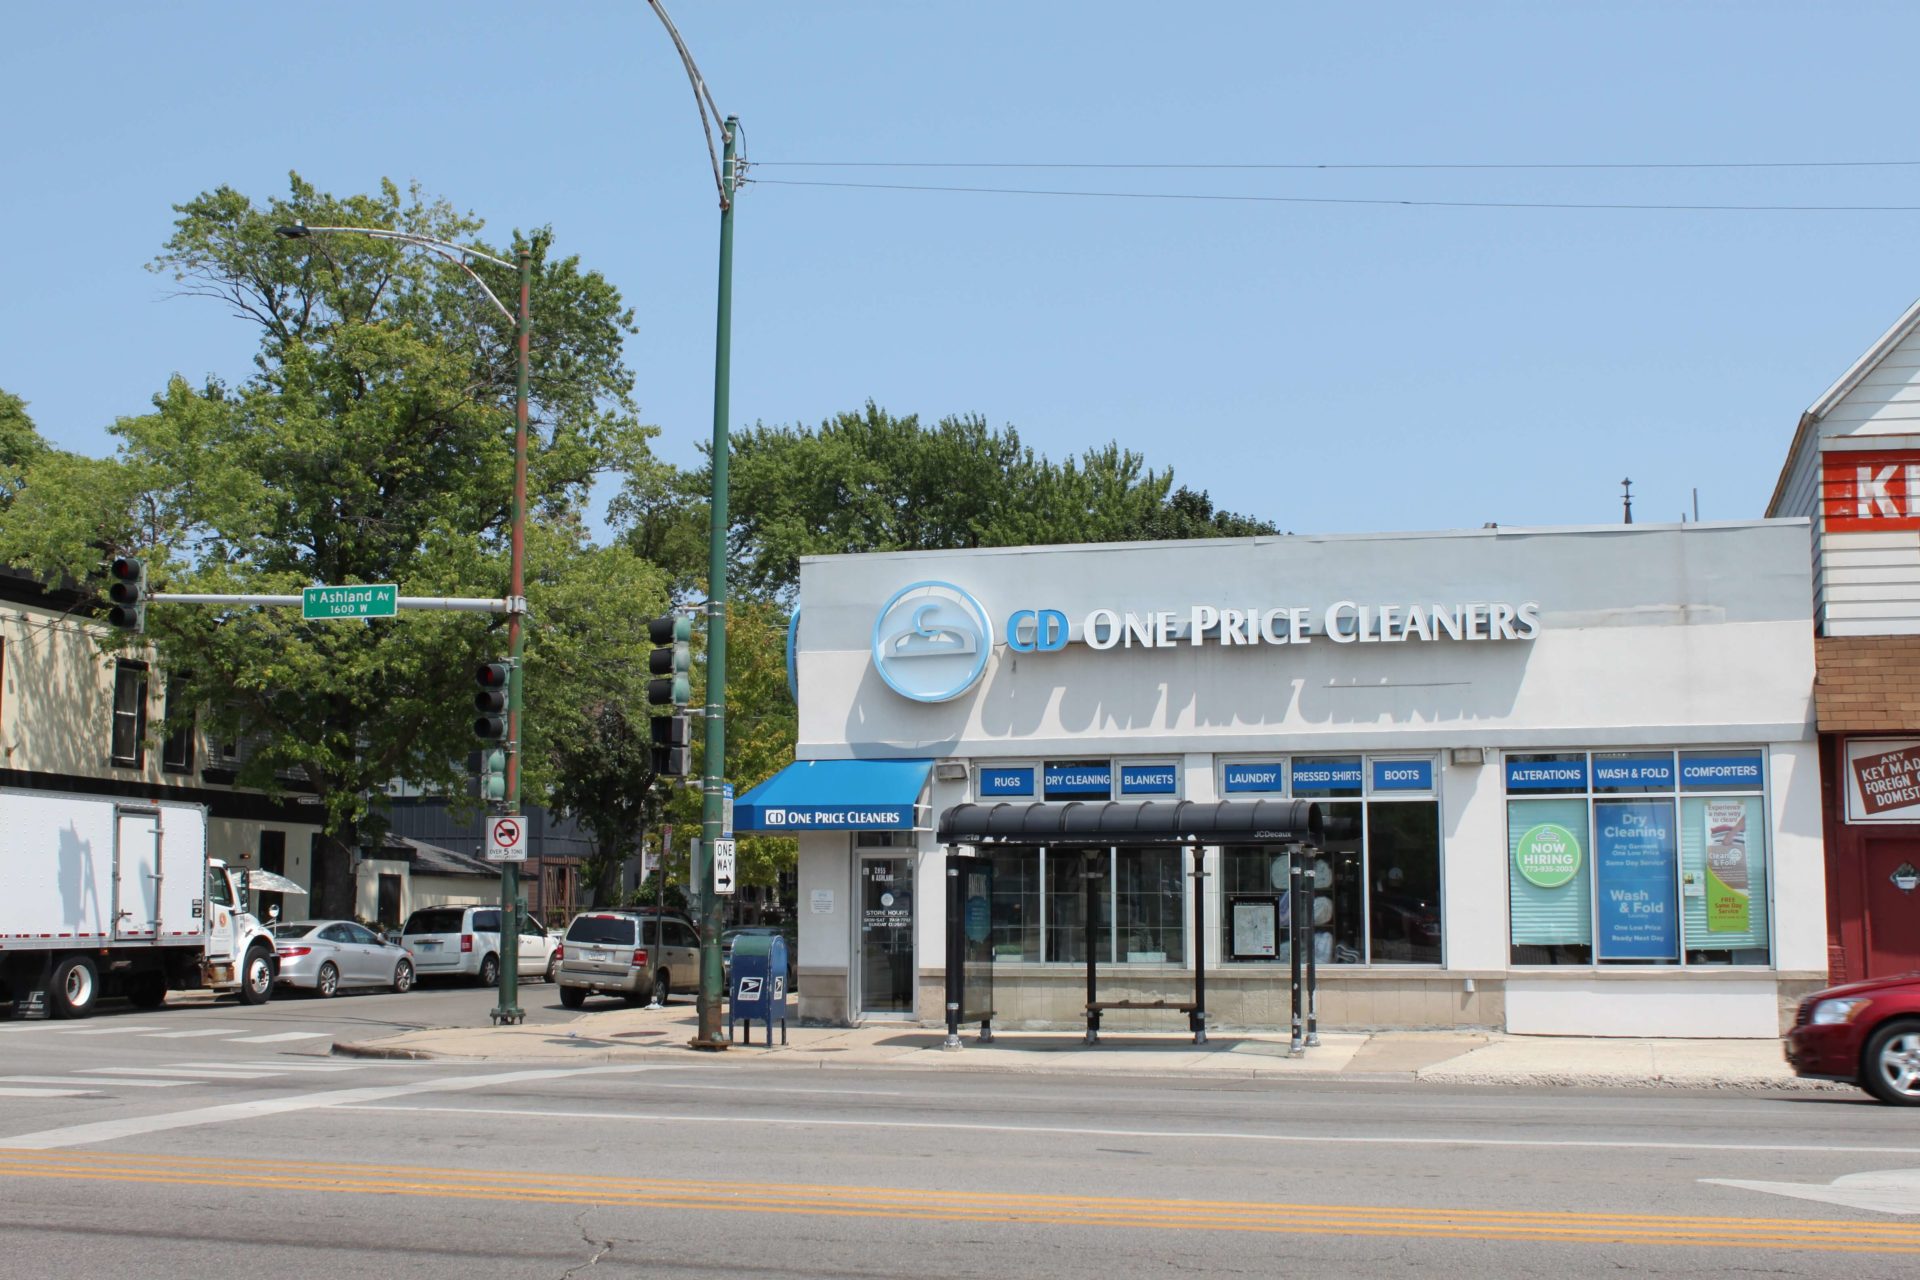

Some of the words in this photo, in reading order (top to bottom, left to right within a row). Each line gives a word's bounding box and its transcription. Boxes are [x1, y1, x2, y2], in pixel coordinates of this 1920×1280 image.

[310, 593, 316, 602] N
[320, 590, 372, 604] Ashland
[377, 591, 390, 601] Av
[330, 604, 355, 614] 1600
[360, 603, 368, 613] W
[1006, 609, 1070, 652] CD
[1084, 608, 1178, 650] ONE
[1191, 604, 1311, 646] PRICE
[1324, 600, 1541, 644] CLEANERS
[1881, 752, 1905, 764] ANY
[1293, 772, 1330, 782] PRESSED
[1332, 770, 1362, 781] SHIRTS
[1384, 770, 1420, 780] BOOTS
[1511, 769, 1581, 781] ALTERATIONS
[1597, 768, 1629, 779] WASH
[1631, 768, 1638, 778] &
[1641, 767, 1669, 778] FOLD
[1684, 766, 1758, 778] COMFORTERS
[1861, 764, 1885, 782] KEY
[994, 777, 1021, 787] RUGS
[1045, 775, 1063, 786] DRY
[1065, 774, 1111, 785] CLEANING
[1124, 774, 1174, 785] BLANKETS
[1229, 773, 1277, 784] LAUNDRY
[1864, 773, 1911, 795] FOREIGN
[767, 811, 784, 824] CD
[788, 811, 812, 824] ONE
[815, 811, 845, 824] PRICE
[847, 811, 900, 824] CLEANERS
[1622, 814, 1648, 828] Dry
[1254, 830, 1292, 838] JCDecaux
[1604, 826, 1666, 840] Cleaning
[503, 848, 510, 856] 5
[717, 844, 733, 857] ONE
[1531, 843, 1566, 854] NOW
[717, 859, 733, 871] WAY
[1524, 854, 1574, 865] HIRING
[1610, 889, 1649, 901] Wash
[1619, 902, 1629, 913] &
[1633, 902, 1664, 913] Fold
